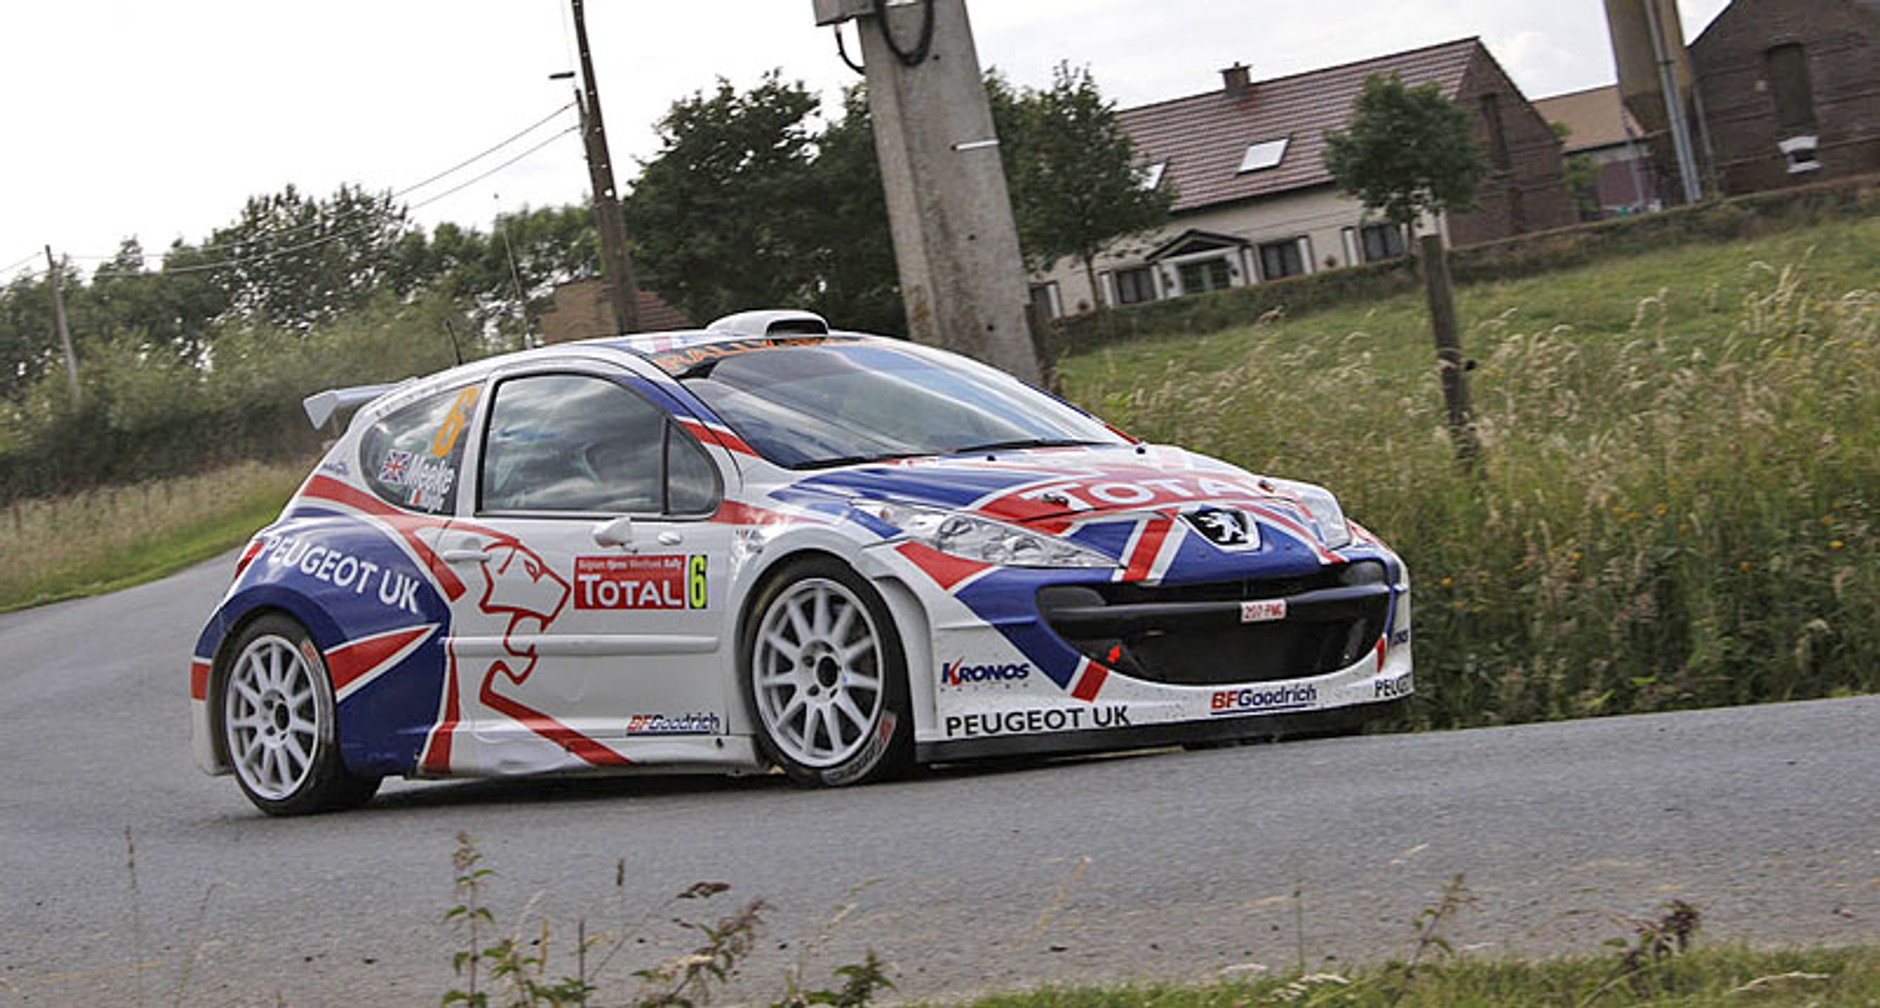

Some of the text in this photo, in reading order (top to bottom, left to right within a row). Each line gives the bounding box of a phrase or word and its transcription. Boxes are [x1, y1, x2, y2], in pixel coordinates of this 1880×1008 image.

[432, 386, 478, 457] 6
[1019, 478, 1262, 512] TOTA
[258, 535, 420, 615] PEUGEOT UK
[578, 573, 683, 607] TOTAL
[690, 555, 707, 608] 6
[941, 656, 1030, 686] KRONOS
[1211, 684, 1318, 710] BFGoodrich
[626, 711, 720, 732] BFGoodrich
[945, 705, 1131, 737] PEUGEOT UK
